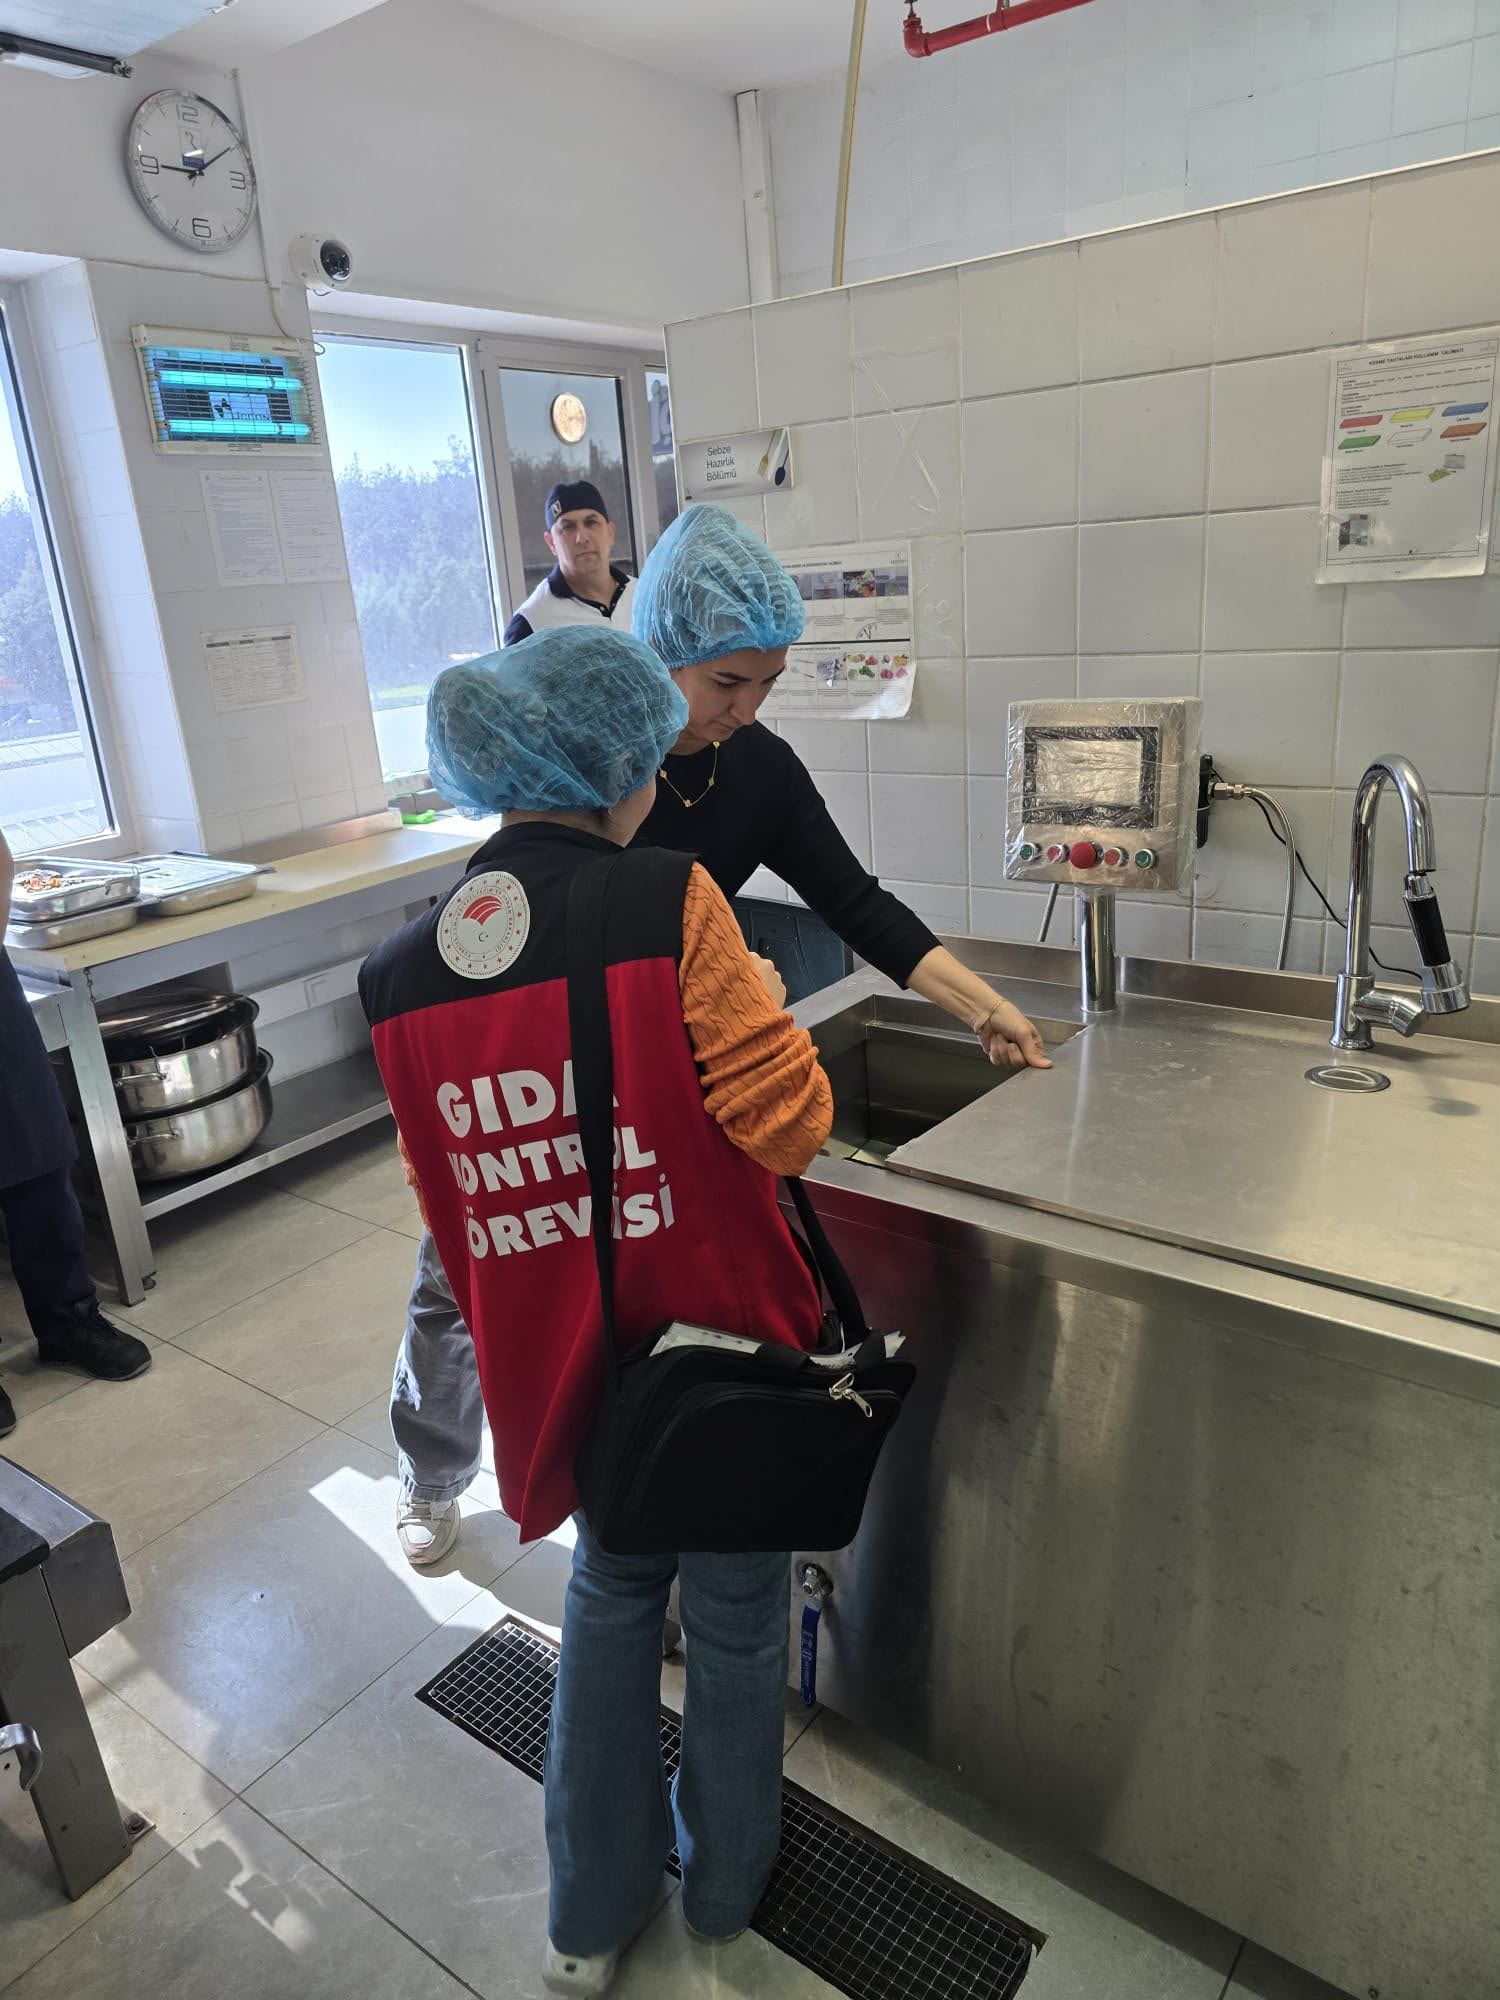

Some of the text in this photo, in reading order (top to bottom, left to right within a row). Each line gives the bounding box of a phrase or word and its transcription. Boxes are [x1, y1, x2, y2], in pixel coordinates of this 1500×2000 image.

[176, 104, 200, 124] 12
[140, 155, 159, 174] 9
[229, 171, 247, 190] 3
[192, 218, 212, 238] 6
[706, 445, 732, 456] Sebze
[706, 457, 735, 469] Hazırlık
[706, 468, 737, 482] Bölümü
